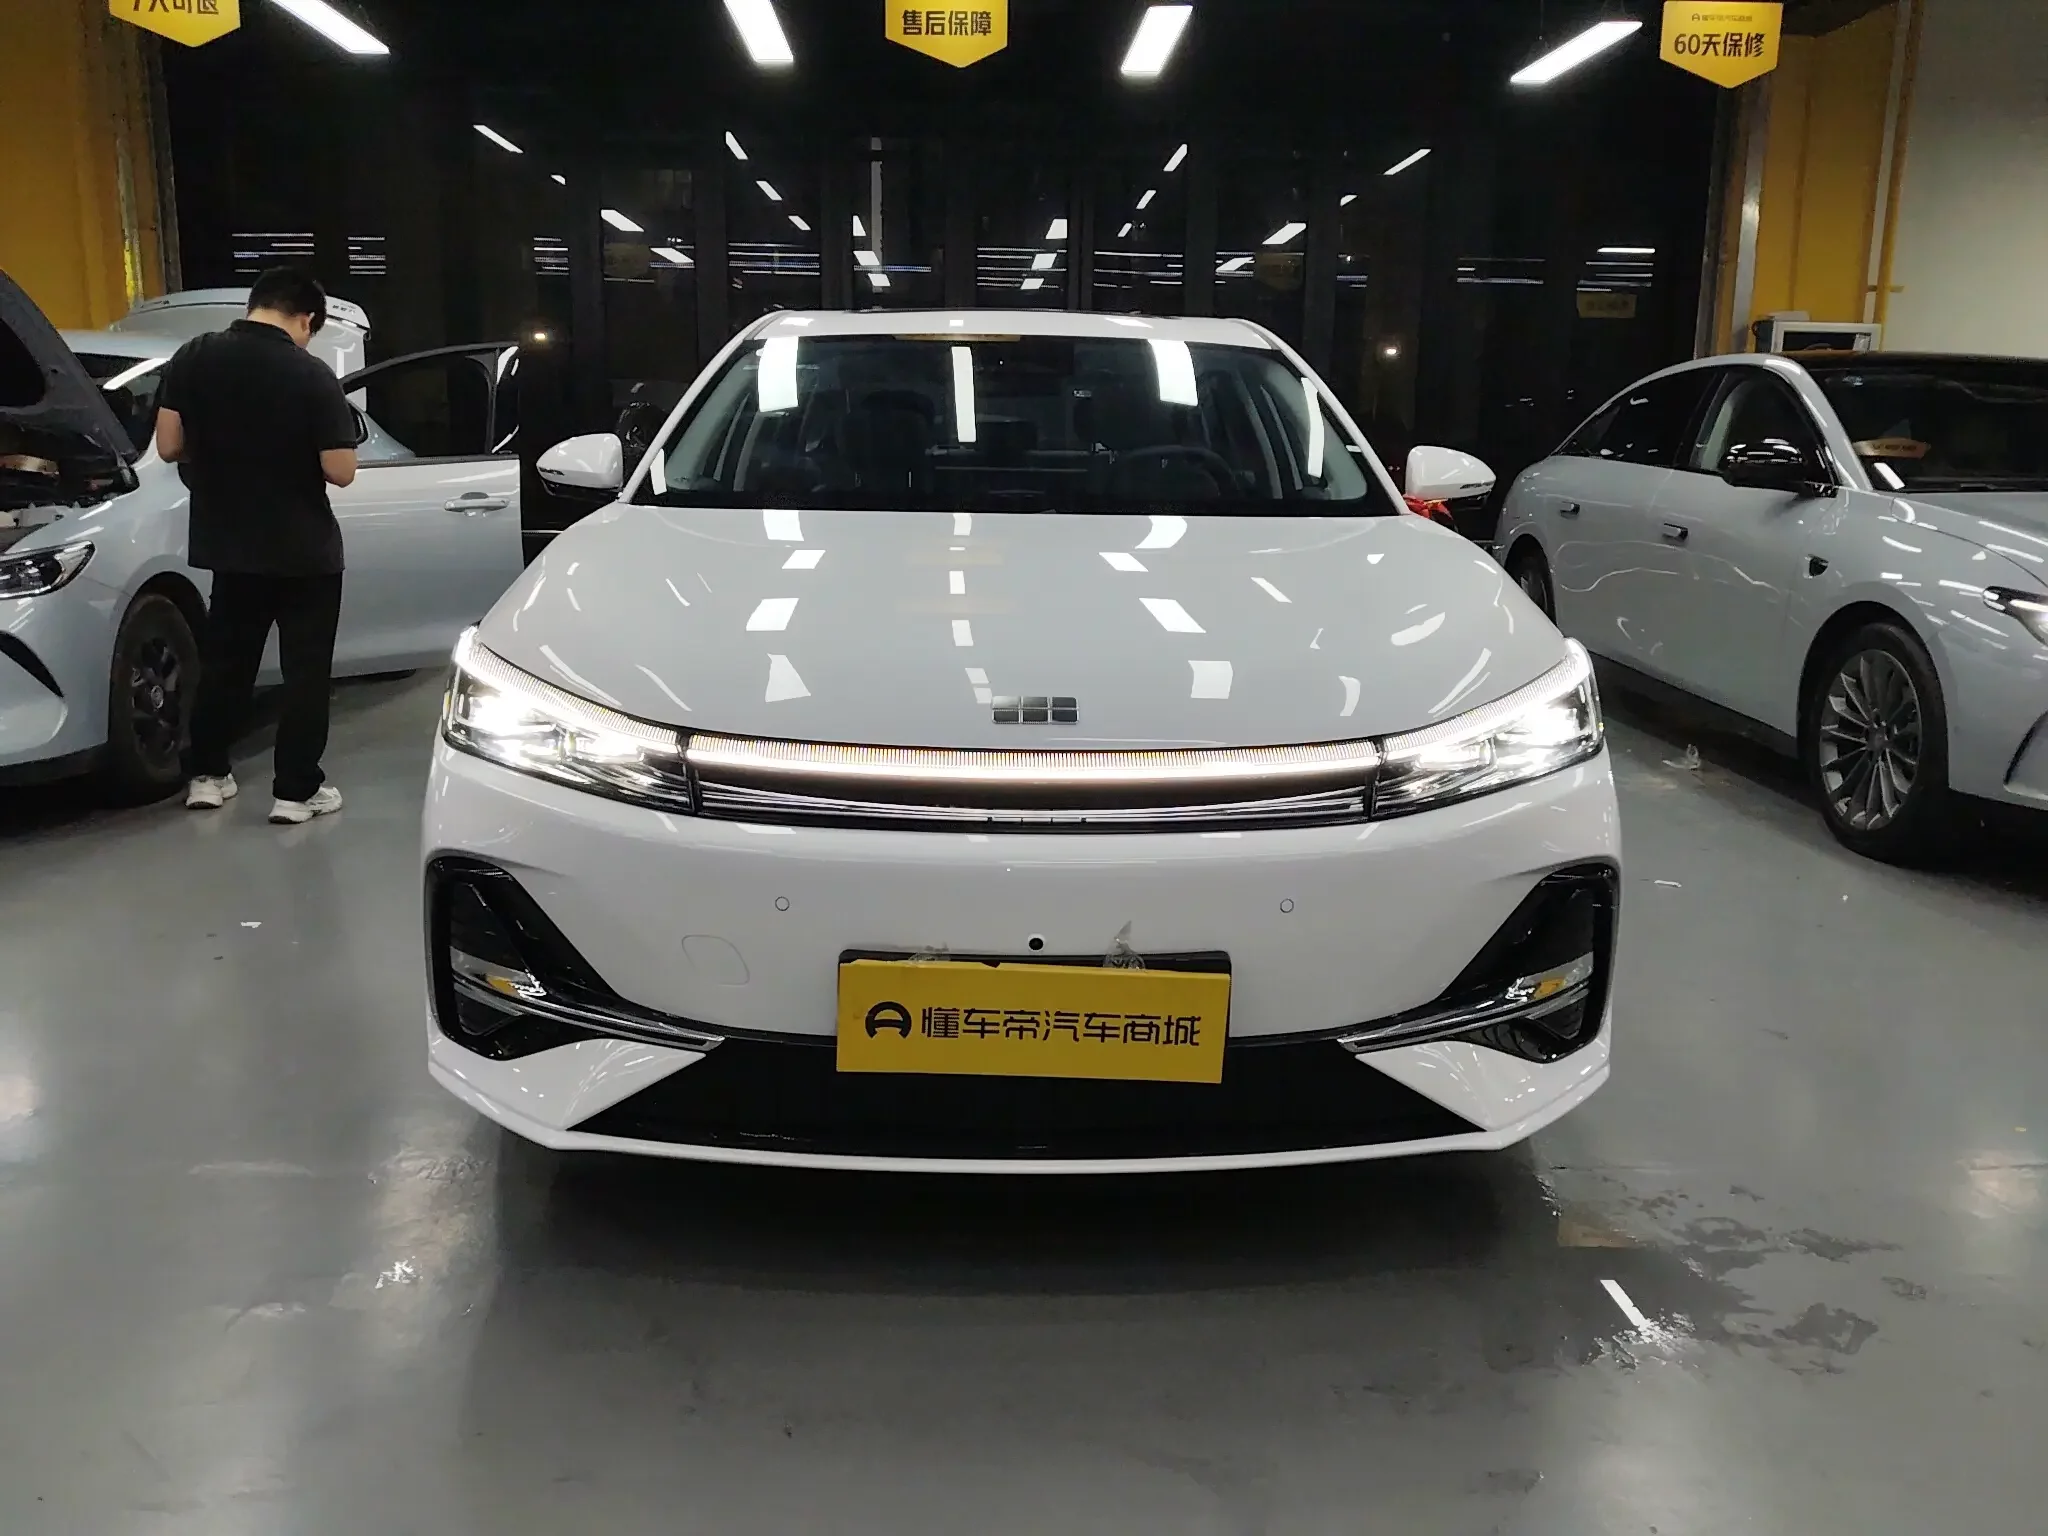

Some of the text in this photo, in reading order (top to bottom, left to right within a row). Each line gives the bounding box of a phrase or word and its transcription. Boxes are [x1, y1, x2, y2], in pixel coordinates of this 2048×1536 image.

[902, 9, 992, 37] 售后保障
[1673, 31, 1766, 58] 60天保修
[921, 1006, 1202, 1046] 懂车帝汽车商城
